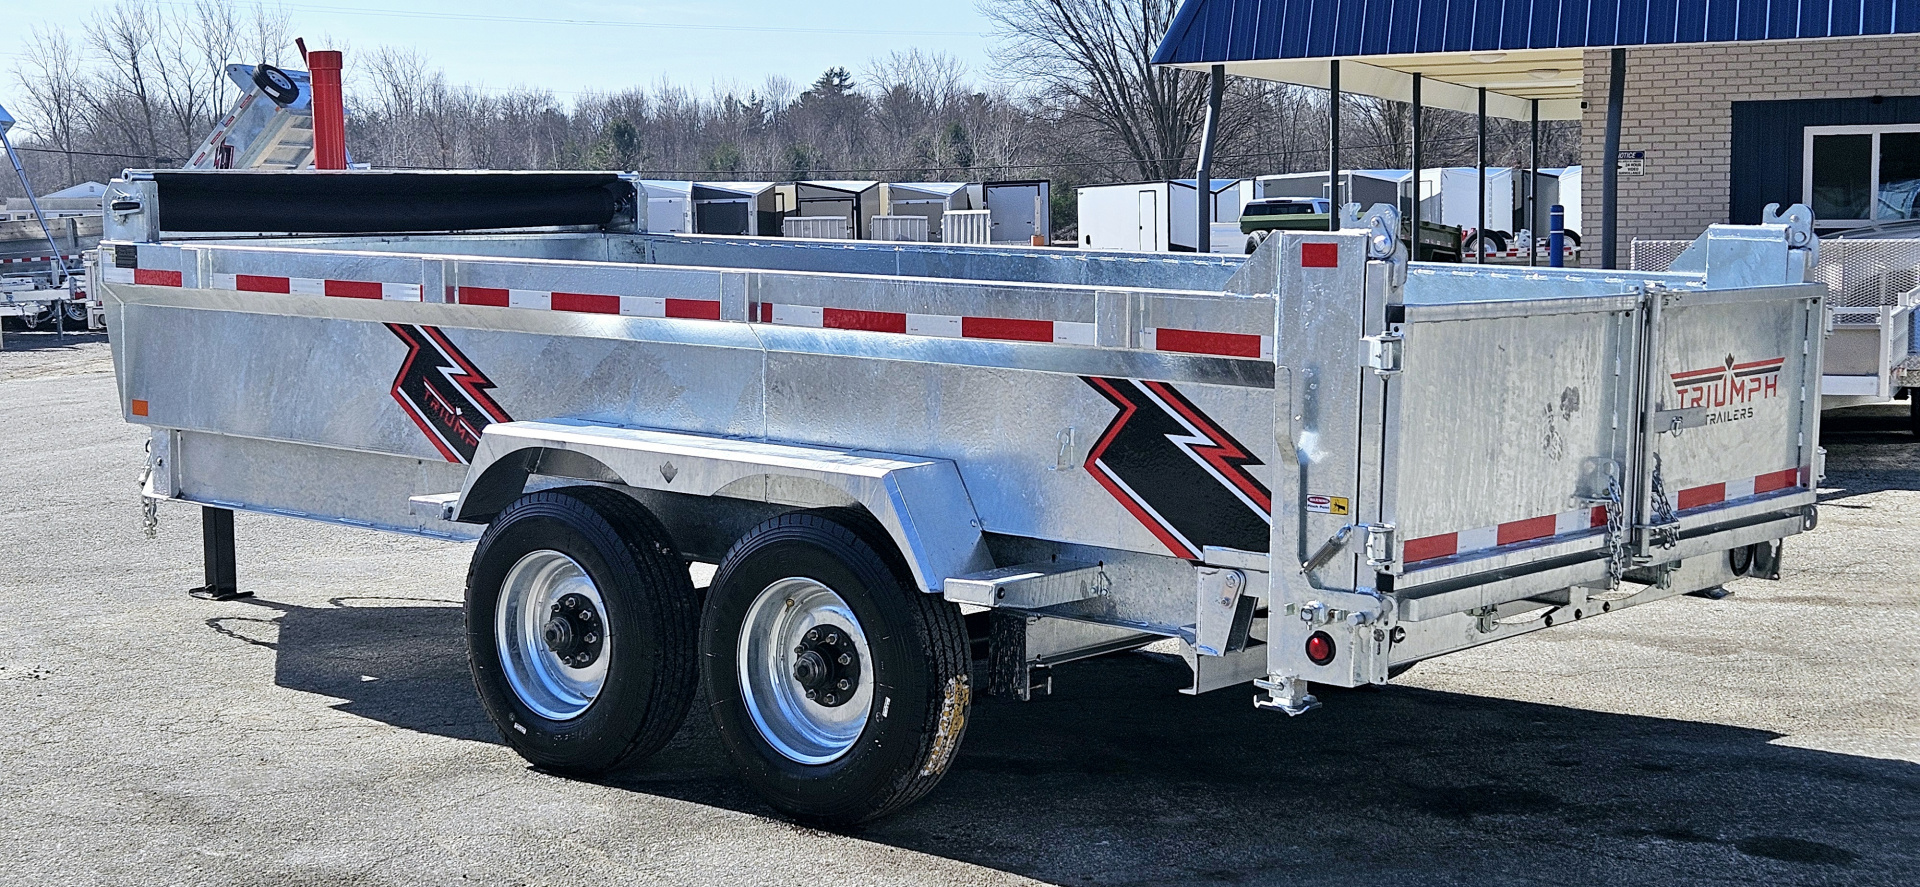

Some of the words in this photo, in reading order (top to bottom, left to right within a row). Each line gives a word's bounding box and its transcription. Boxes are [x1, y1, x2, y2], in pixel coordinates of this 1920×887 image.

[1677, 374, 1778, 409] TRIUMPH
[424, 388, 478, 447] TRIUMP
[1705, 407, 1754, 425] TRAILERS
